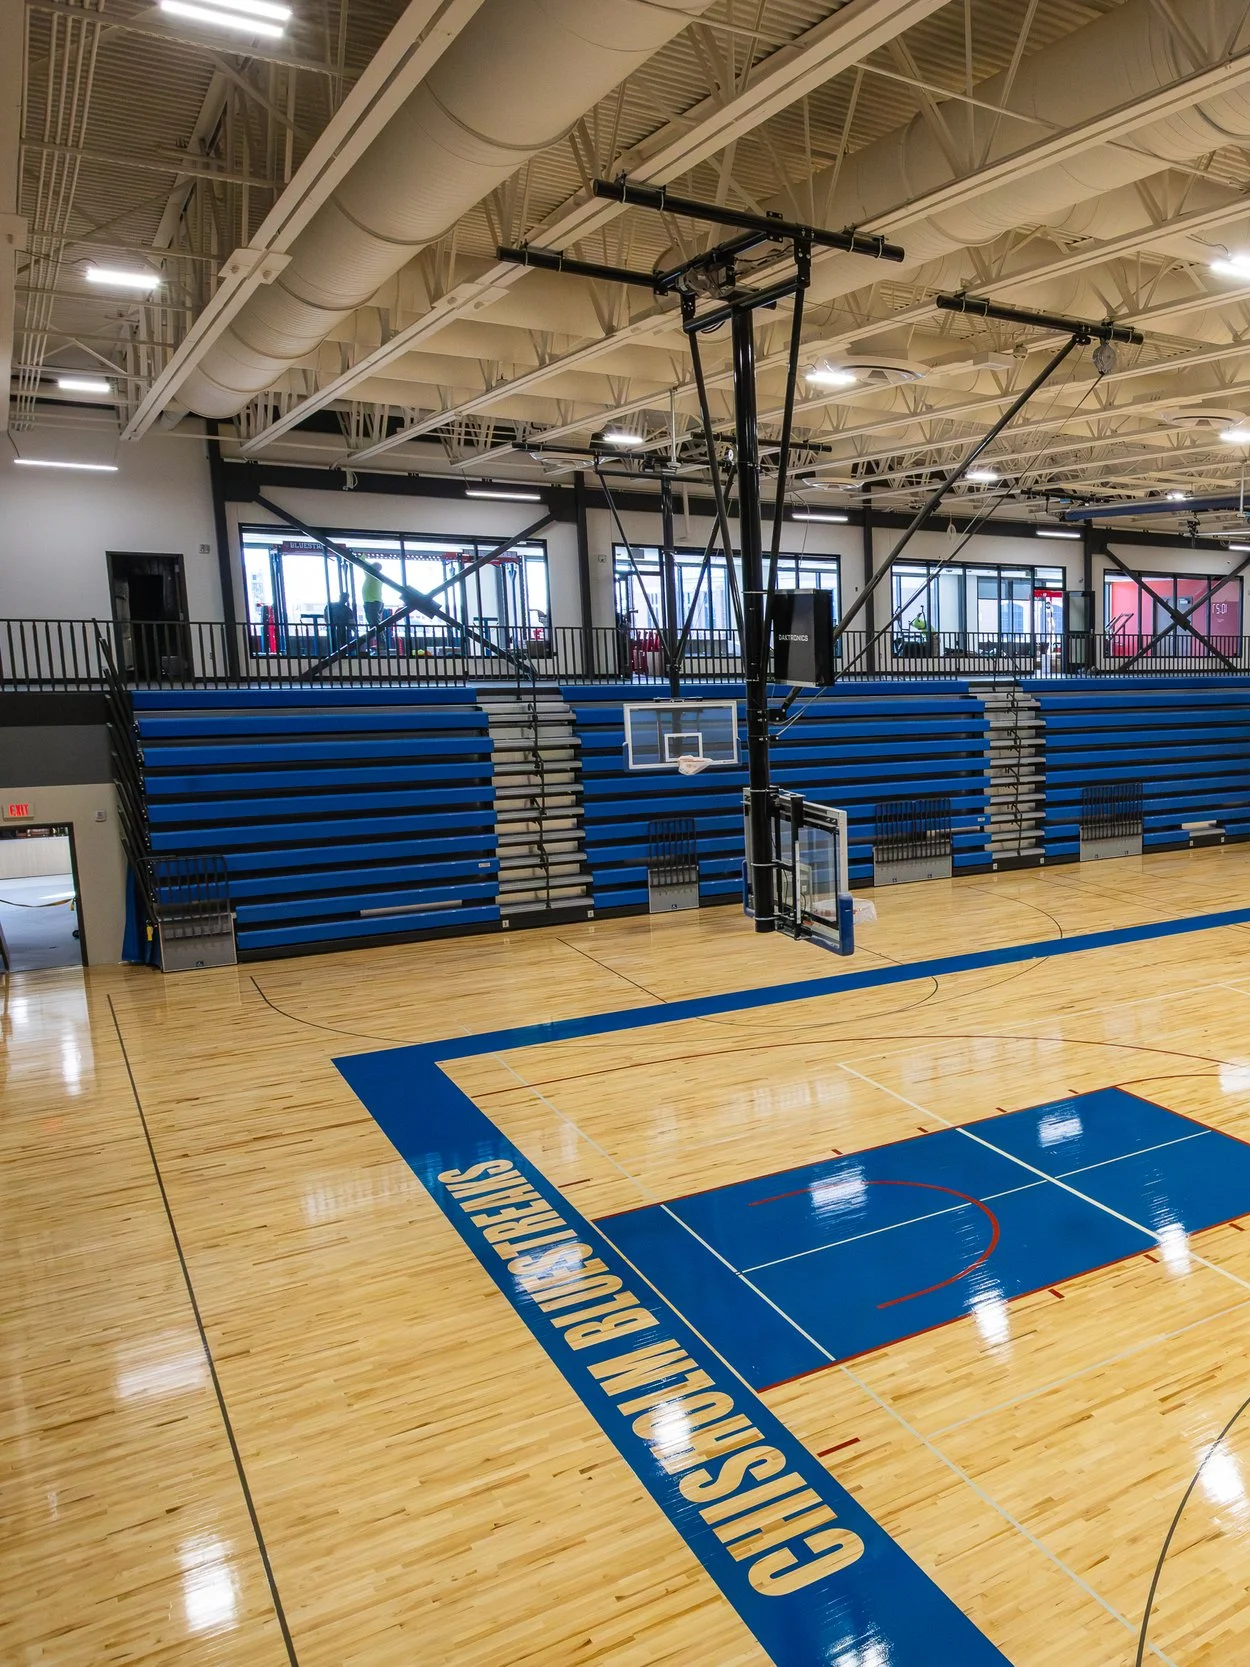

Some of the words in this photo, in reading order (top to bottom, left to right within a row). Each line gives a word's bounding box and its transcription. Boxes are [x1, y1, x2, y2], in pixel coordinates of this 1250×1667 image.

[778, 634, 808, 642] DAKTRONICS
[9, 803, 29, 817] EXIT
[437, 1158, 660, 1351] BLUESTREAKS
[586, 1338, 865, 1597] CHISHOLM
